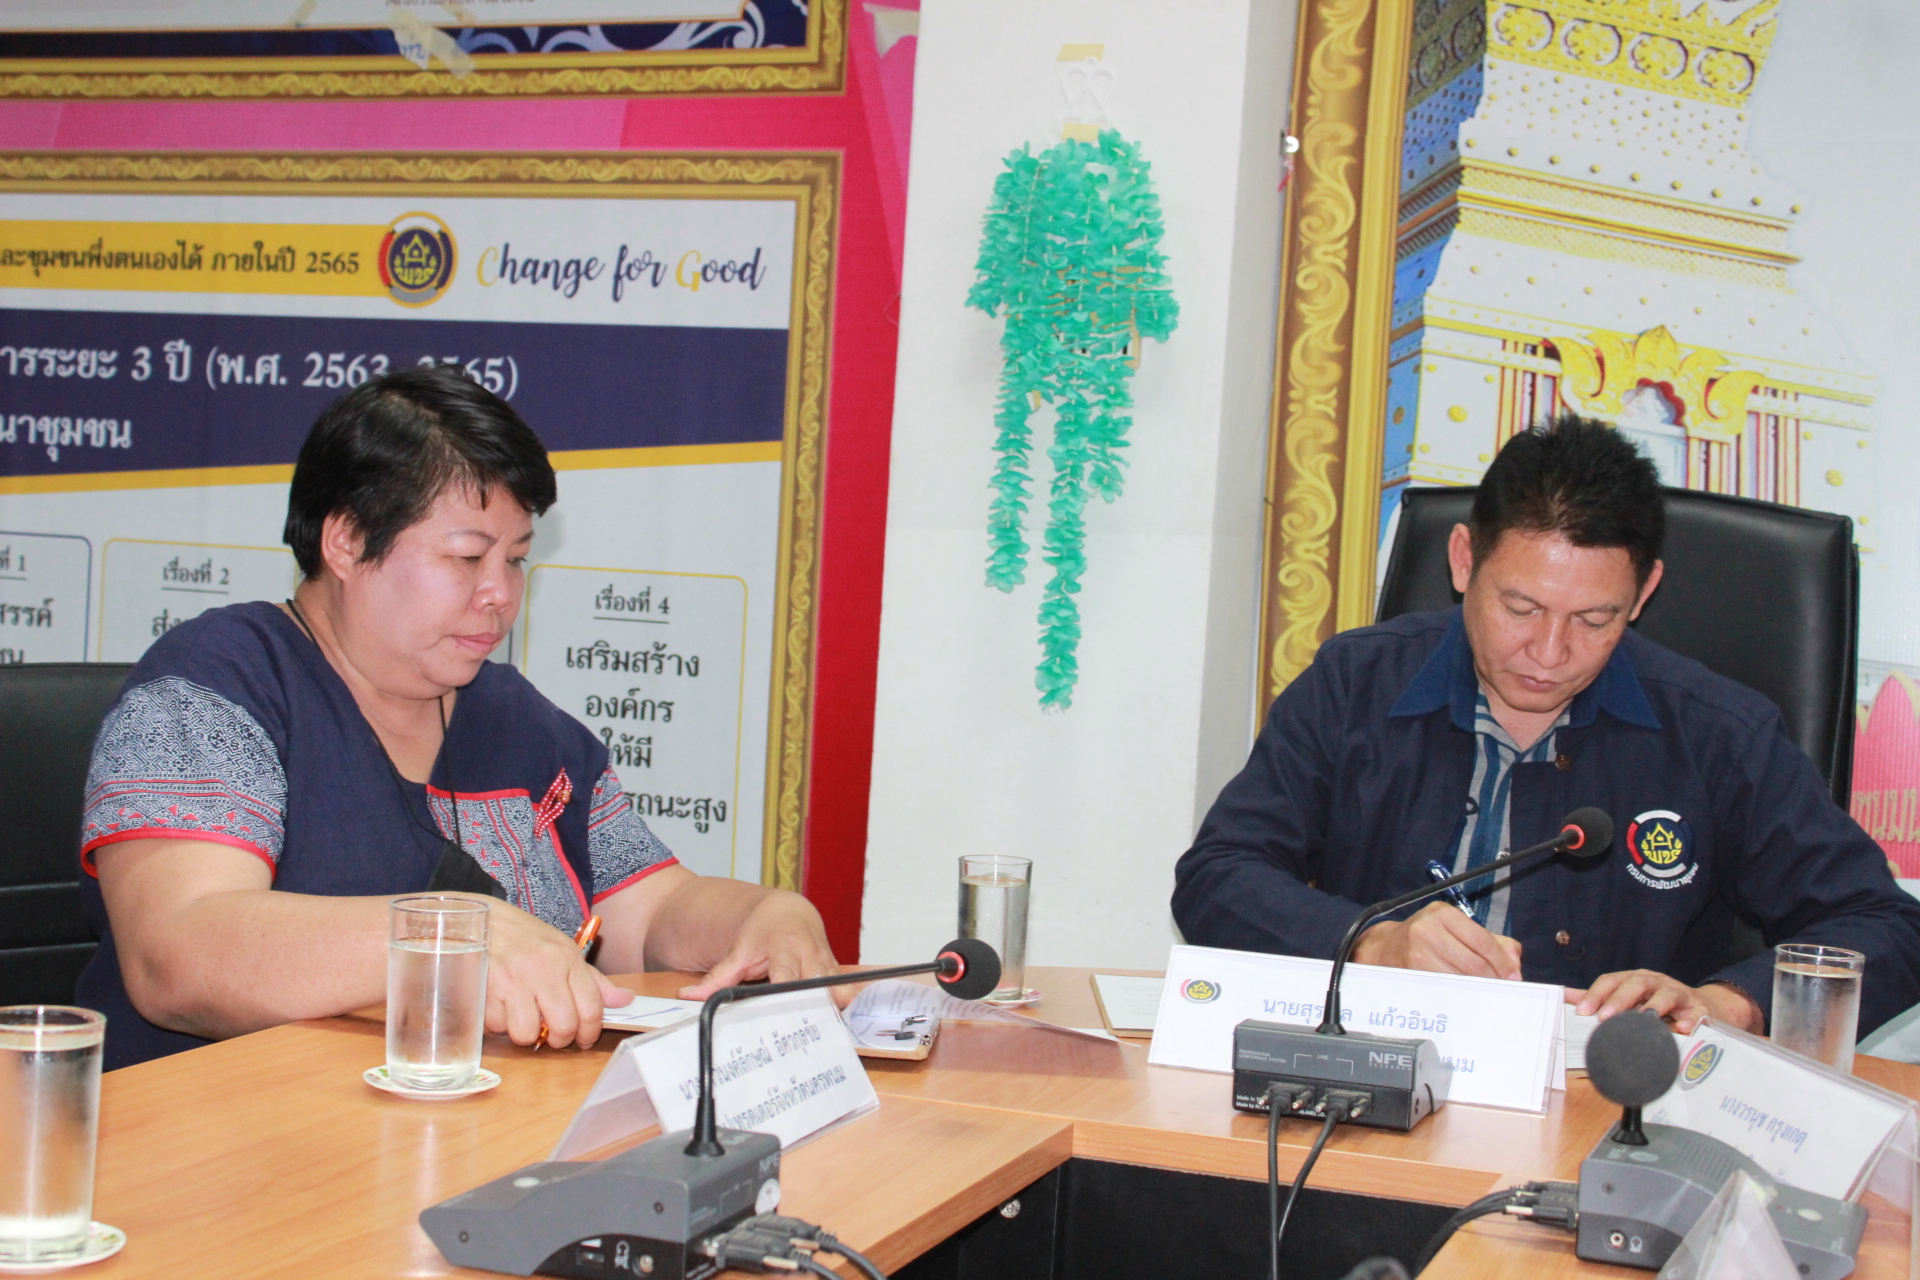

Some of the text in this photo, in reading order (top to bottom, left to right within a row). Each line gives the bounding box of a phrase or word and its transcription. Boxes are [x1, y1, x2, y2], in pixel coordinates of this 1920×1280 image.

[211, 240, 296, 273] ภายในปี
[305, 251, 360, 274] 2565
[476, 242, 767, 302] Change for Good
[131, 347, 153, 382] 3
[164, 339, 191, 383] ปี
[206, 346, 288, 391] (พ.ศ.
[19, 554, 26, 572] 1
[163, 556, 230, 586] เรื่องที่ 2
[594, 584, 671, 615] เรื่องที่ 4
[565, 640, 700, 678] เสริมสร้าง
[585, 687, 675, 724] องค์กร
[1263, 998, 1448, 1034] นายสุรล แก้วอินธิ
[1369, 1050, 1412, 1067] NPE
